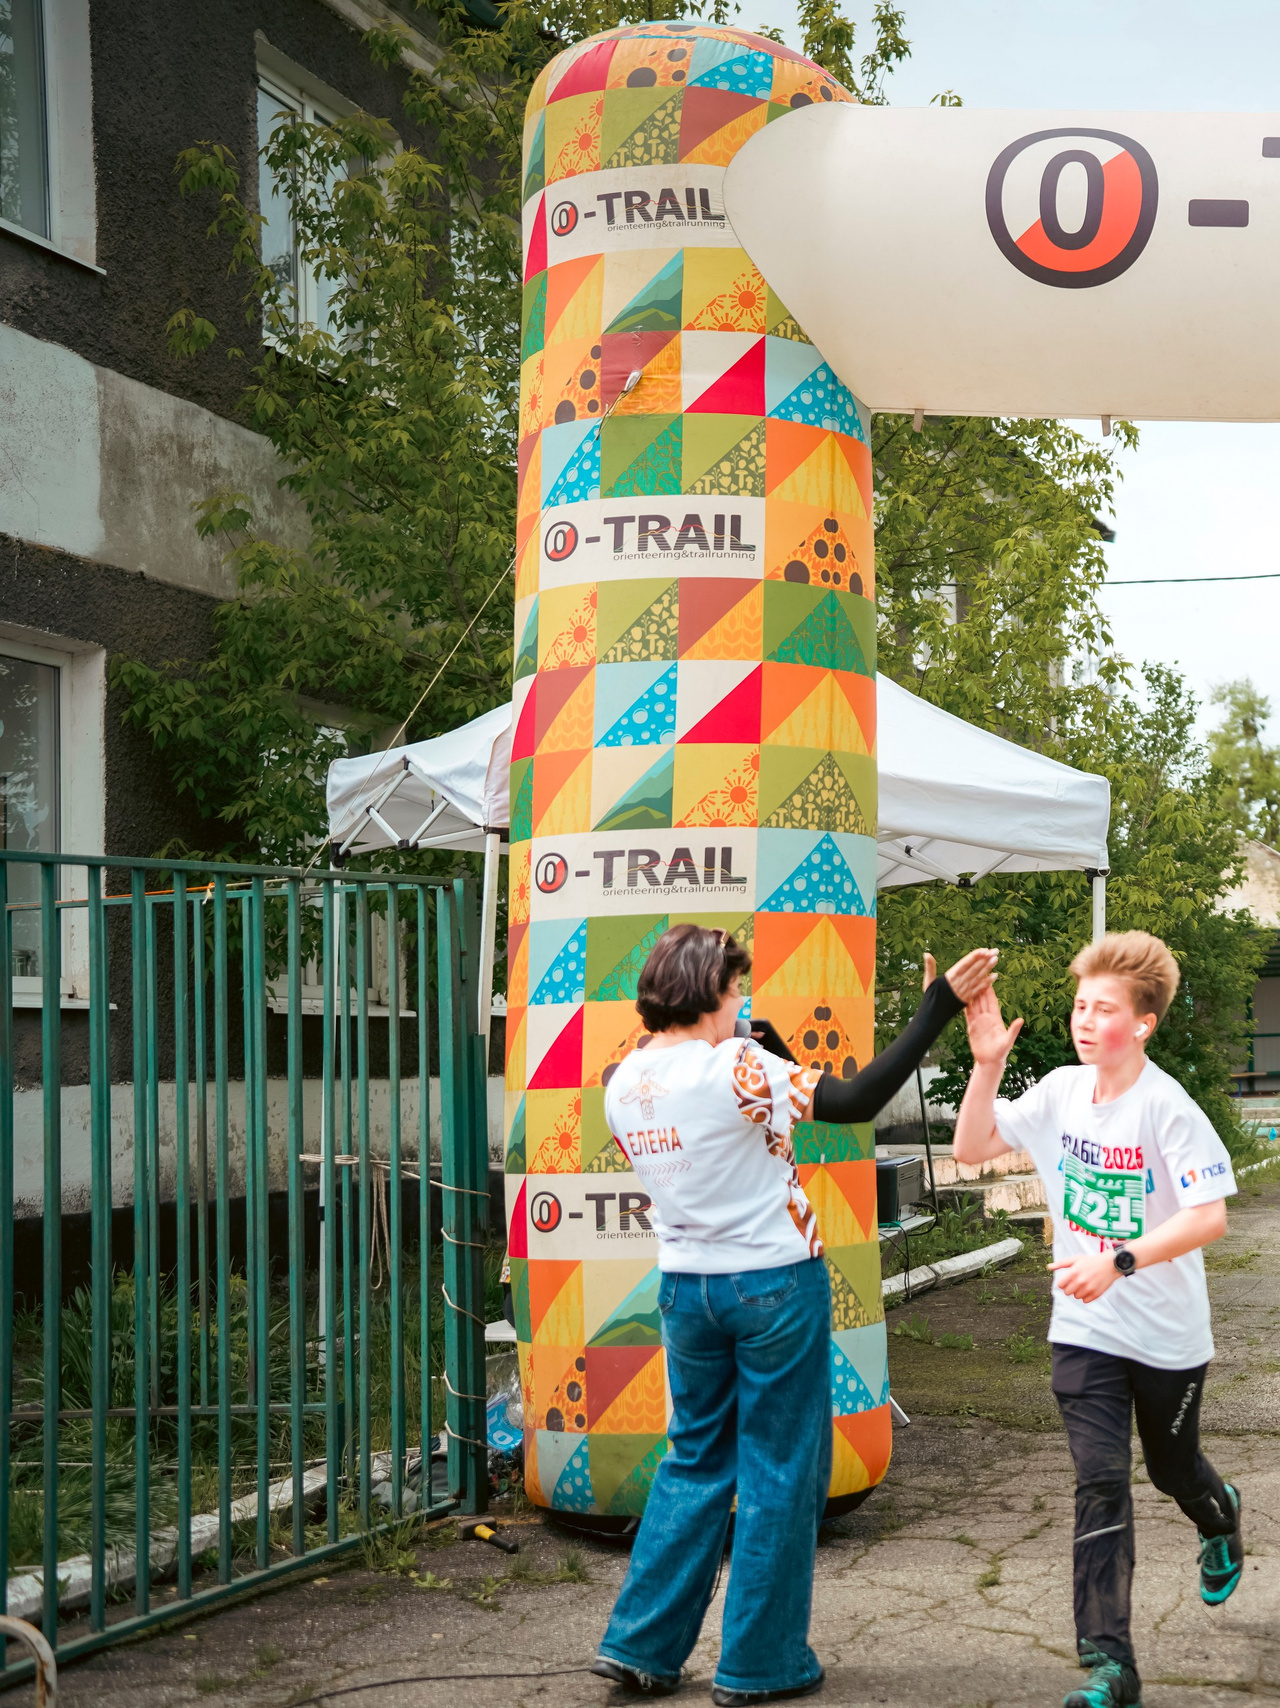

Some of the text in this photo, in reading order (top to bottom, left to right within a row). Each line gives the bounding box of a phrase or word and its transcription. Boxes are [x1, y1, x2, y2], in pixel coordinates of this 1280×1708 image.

[607, 219, 726, 233] orienteering&trailrunning
[613, 549, 756, 562] orienteering&trailrunning
[602, 883, 748, 897] orienteering&trailrunning
[626, 1126, 684, 1156] ЕЛЕНА
[1201, 1162, 1226, 1179] ПСБ
[1069, 1179, 1139, 1233] 721
